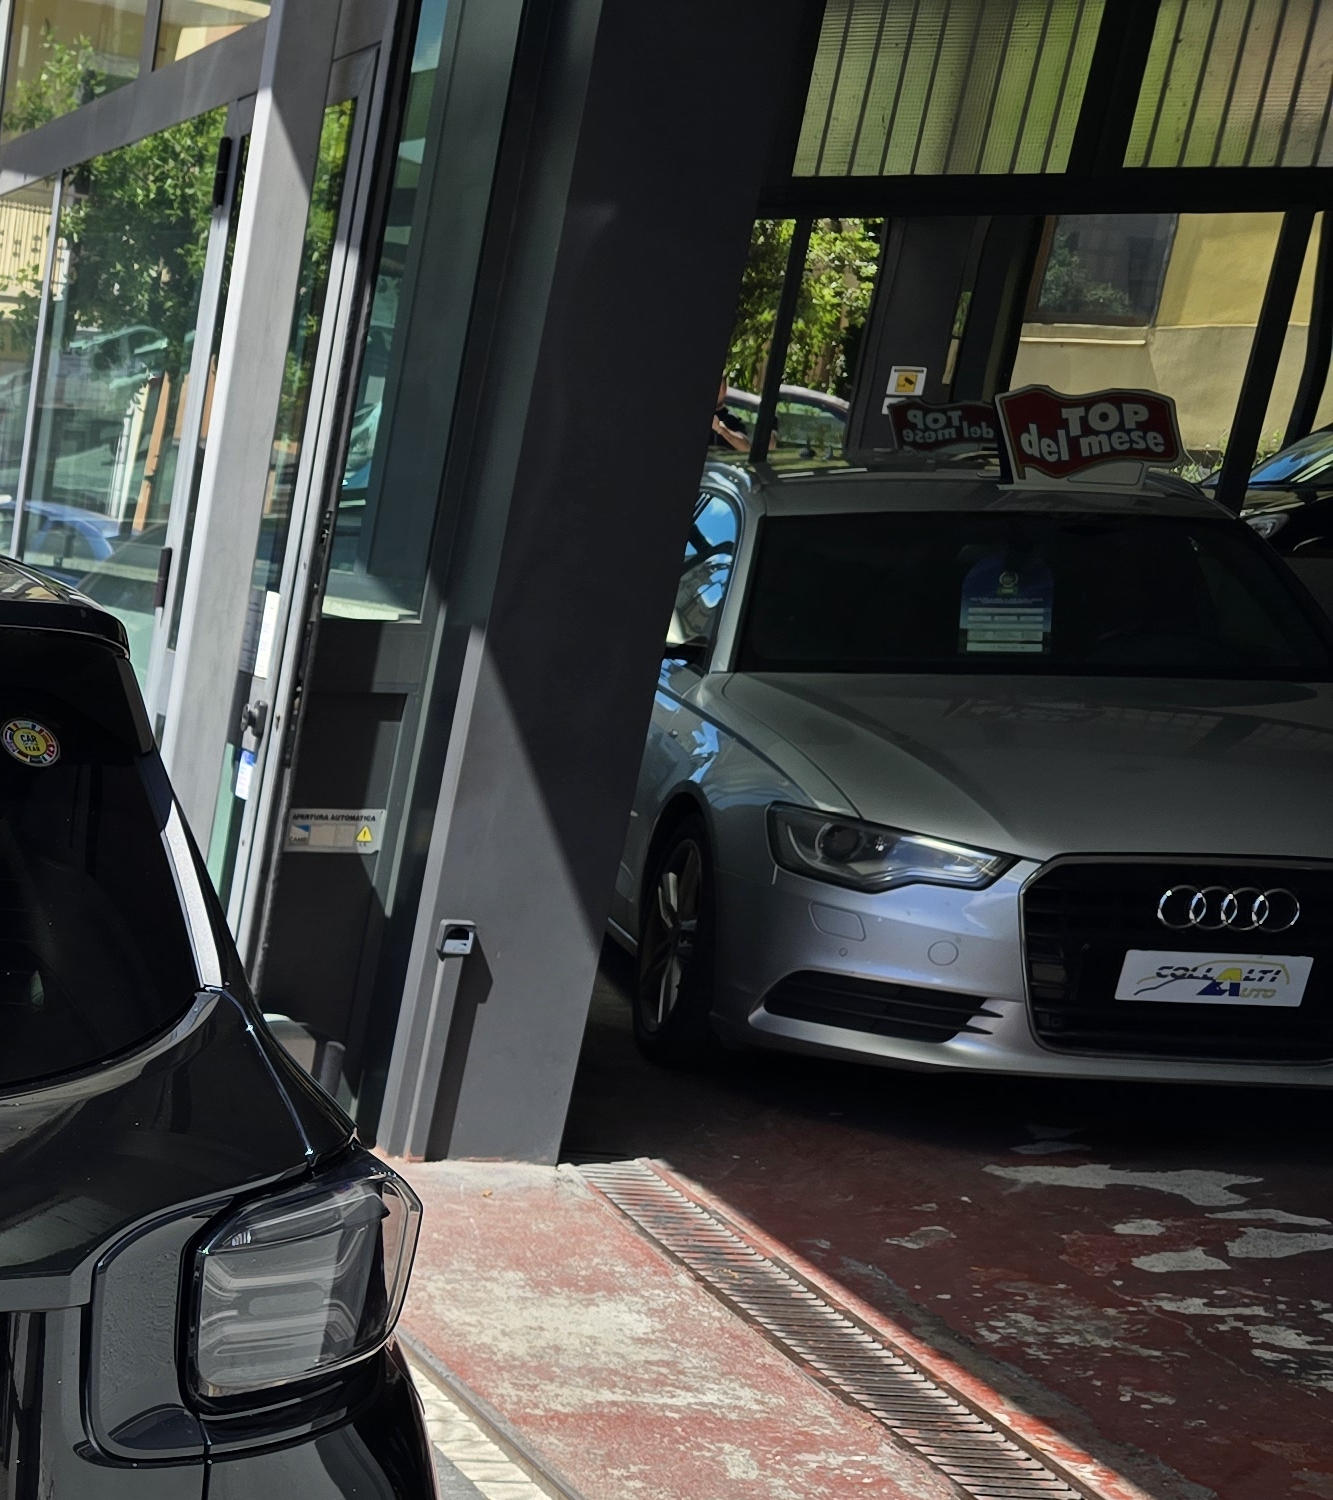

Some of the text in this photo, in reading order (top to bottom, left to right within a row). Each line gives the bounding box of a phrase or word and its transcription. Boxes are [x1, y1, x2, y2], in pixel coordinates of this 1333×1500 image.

[1060, 402, 1149, 437] TOP
[1020, 423, 1165, 462] del mese
[20, 734, 38, 743] CAR
[292, 813, 376, 822] APERTURA AUTOMATICA
[1156, 966, 1282, 982] COLLALTI
